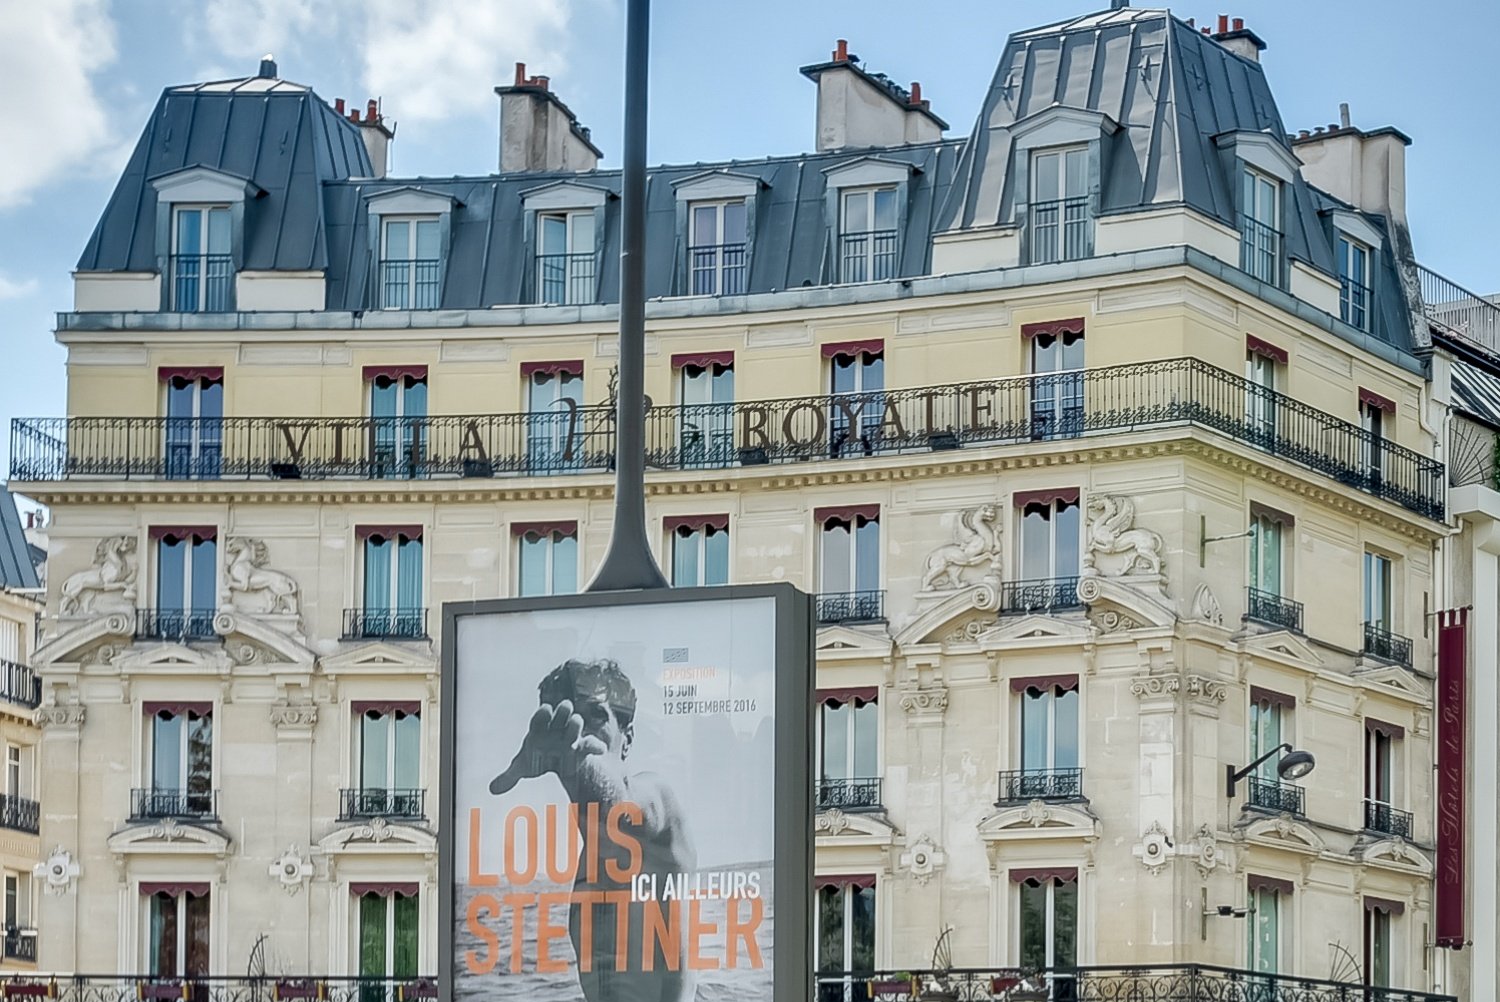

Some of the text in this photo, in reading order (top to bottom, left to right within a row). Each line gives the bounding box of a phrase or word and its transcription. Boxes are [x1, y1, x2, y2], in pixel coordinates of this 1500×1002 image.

[739, 386, 997, 450] ROYALE
[663, 666, 716, 680] EXPOSITION
[663, 684, 698, 697] 15 JUIN
[663, 699, 756, 715] 12 SEPTEMBRE 2016
[468, 801, 644, 887] LOUIS
[630, 872, 761, 902] ICI AILLEURS
[464, 888, 766, 976] STETTNER
